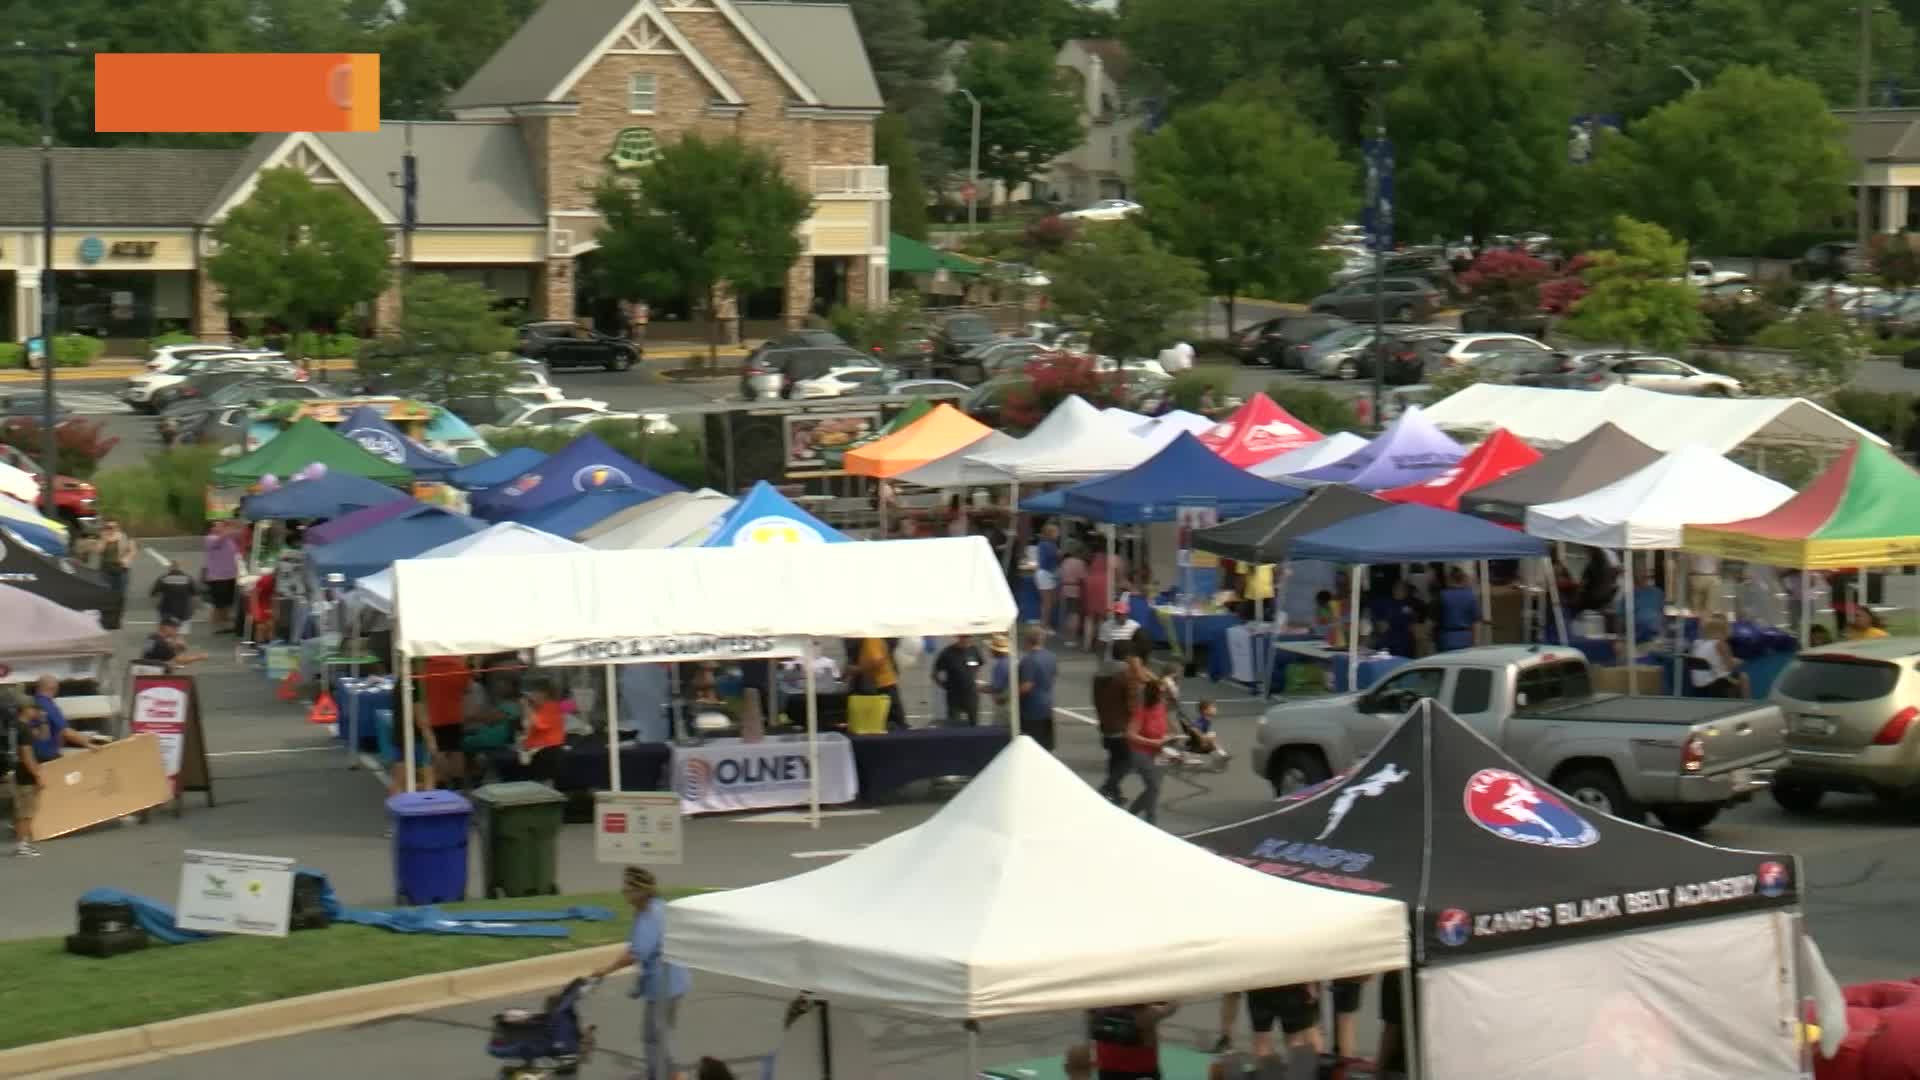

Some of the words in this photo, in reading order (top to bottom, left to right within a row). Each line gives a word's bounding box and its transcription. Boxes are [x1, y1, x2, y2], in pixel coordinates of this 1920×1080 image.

[717, 755, 813, 784] OLNEY
[1473, 906, 1552, 935] KANG'S
[1555, 895, 1622, 925] BLACK
[1624, 888, 1670, 914] BELT
[1674, 874, 1757, 907] ACADEMY
